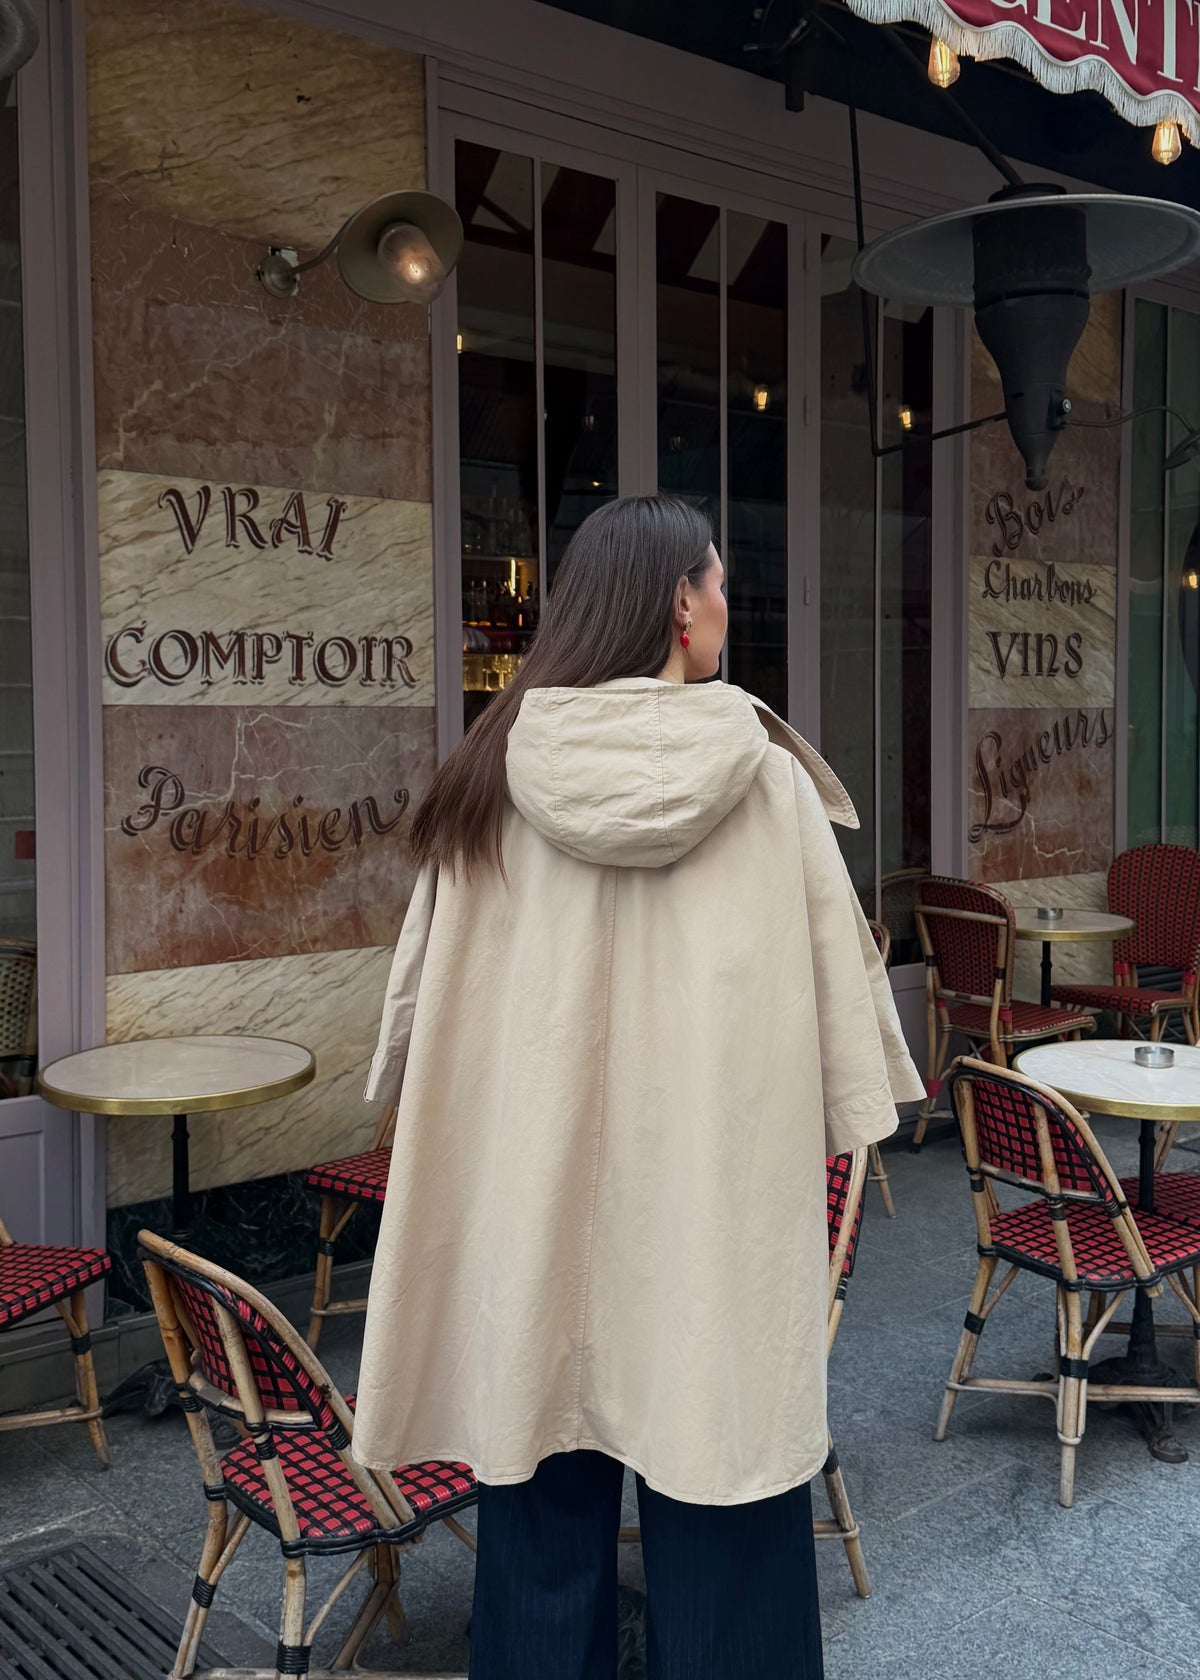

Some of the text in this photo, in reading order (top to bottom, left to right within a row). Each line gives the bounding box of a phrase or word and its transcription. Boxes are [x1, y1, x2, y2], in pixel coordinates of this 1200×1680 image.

[158, 485, 347, 561] VRAI
[982, 560, 1097, 606] Charbons
[105, 620, 420, 688] COMPTOIR
[121, 765, 410, 860] Parisien
[968, 707, 1114, 843] Liqueurs
